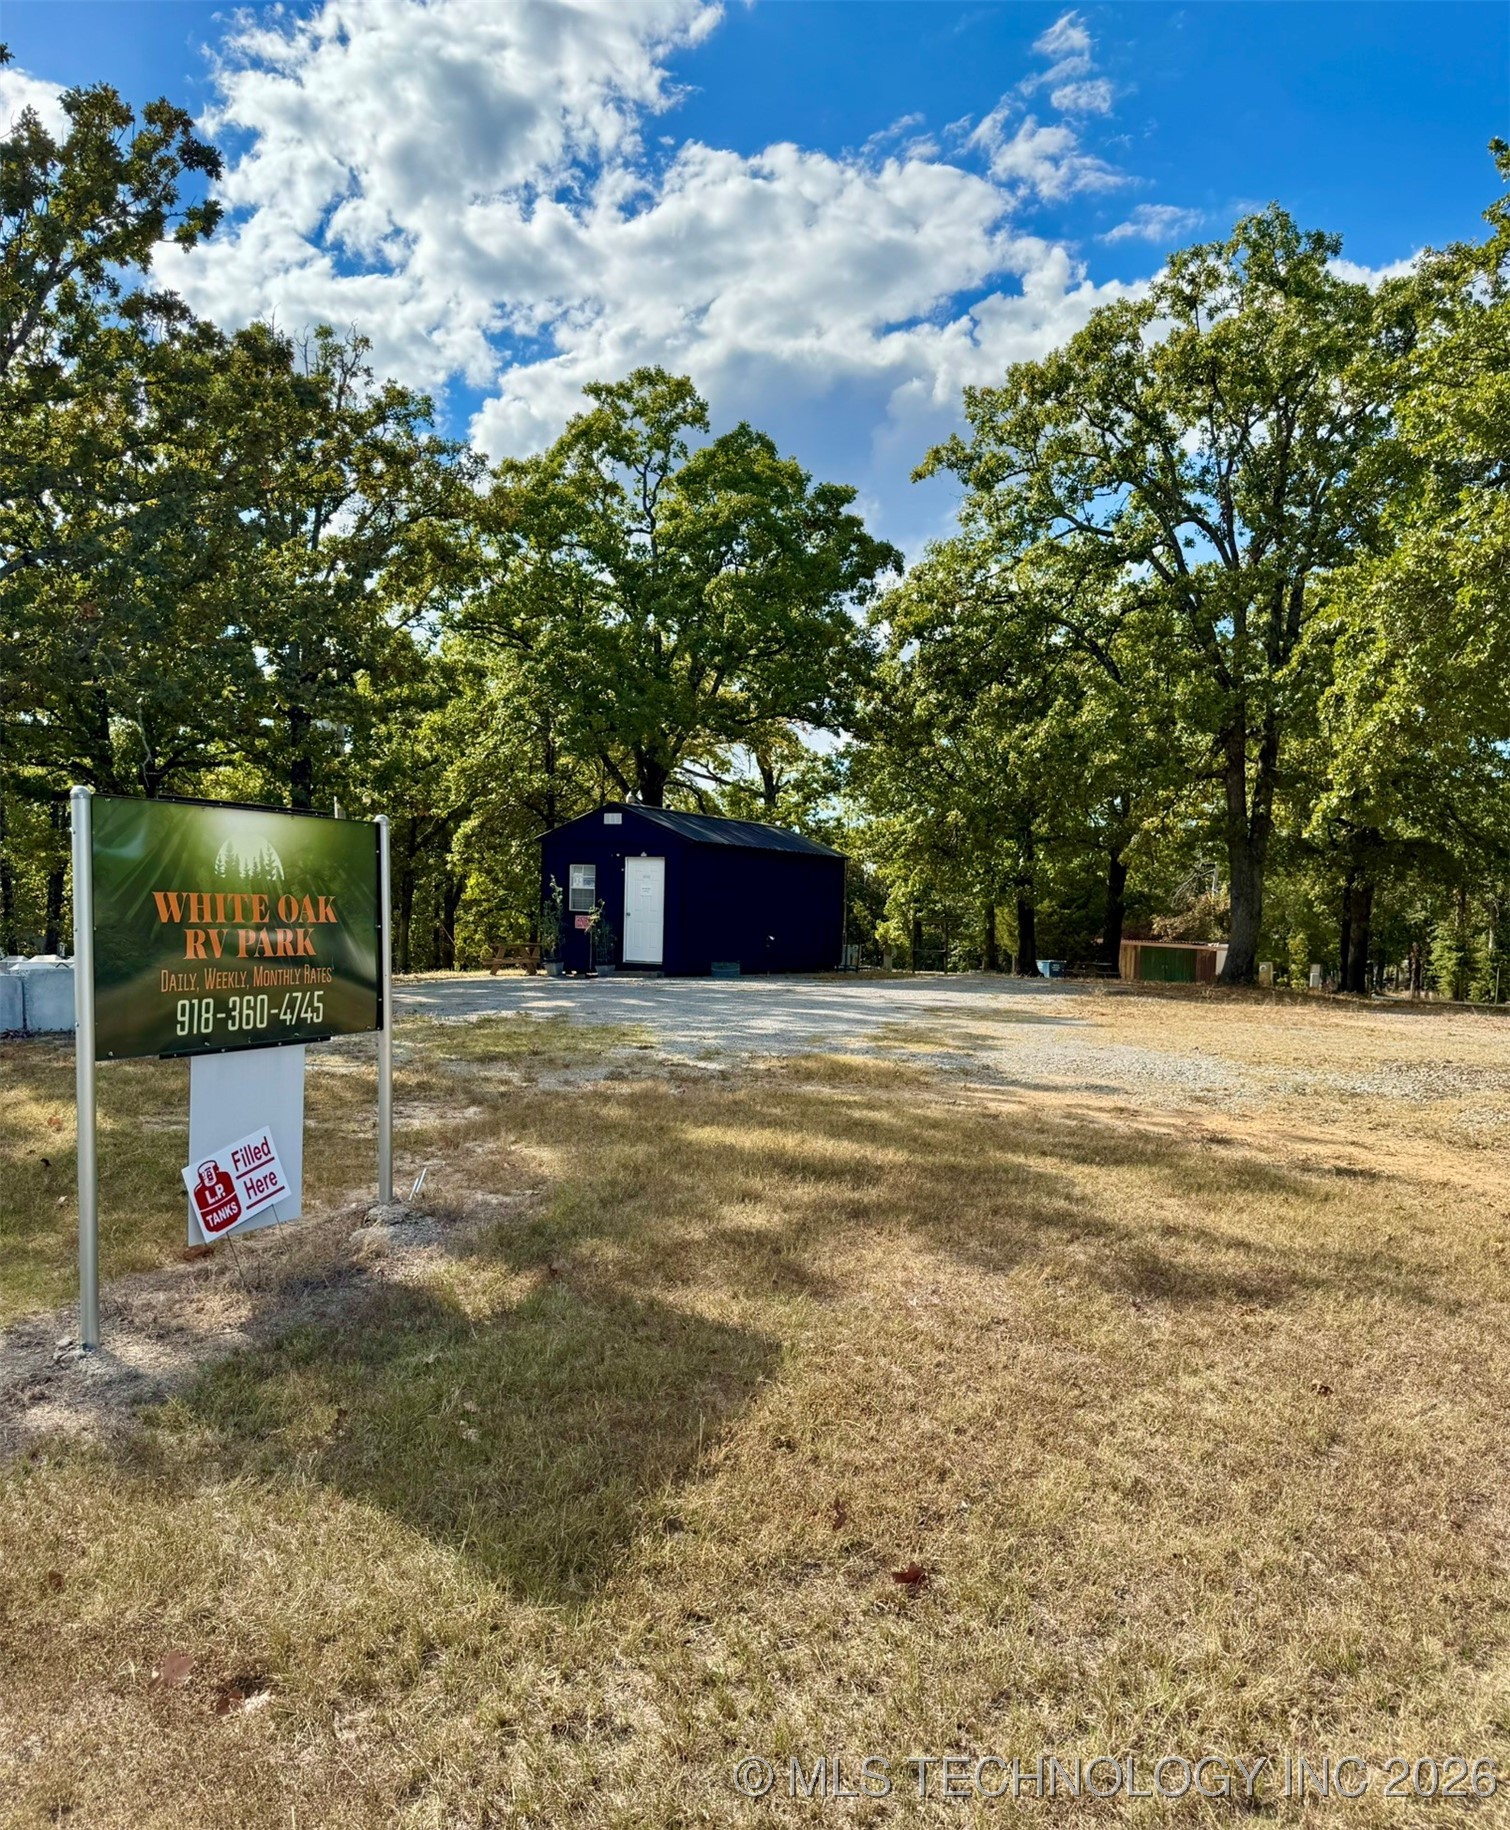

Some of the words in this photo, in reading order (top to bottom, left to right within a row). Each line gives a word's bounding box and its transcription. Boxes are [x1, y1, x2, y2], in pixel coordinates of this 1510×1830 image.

[153, 891, 270, 923] WHITE
[278, 894, 338, 923] OAK
[183, 929, 228, 960] RV
[236, 928, 317, 958] PARK
[176, 991, 324, 1036] 918-360-4745
[231, 1135, 271, 1172] Filled
[205, 1183, 226, 1205] L.P.
[243, 1171, 278, 1200] Here
[205, 1201, 239, 1227] TANKS
